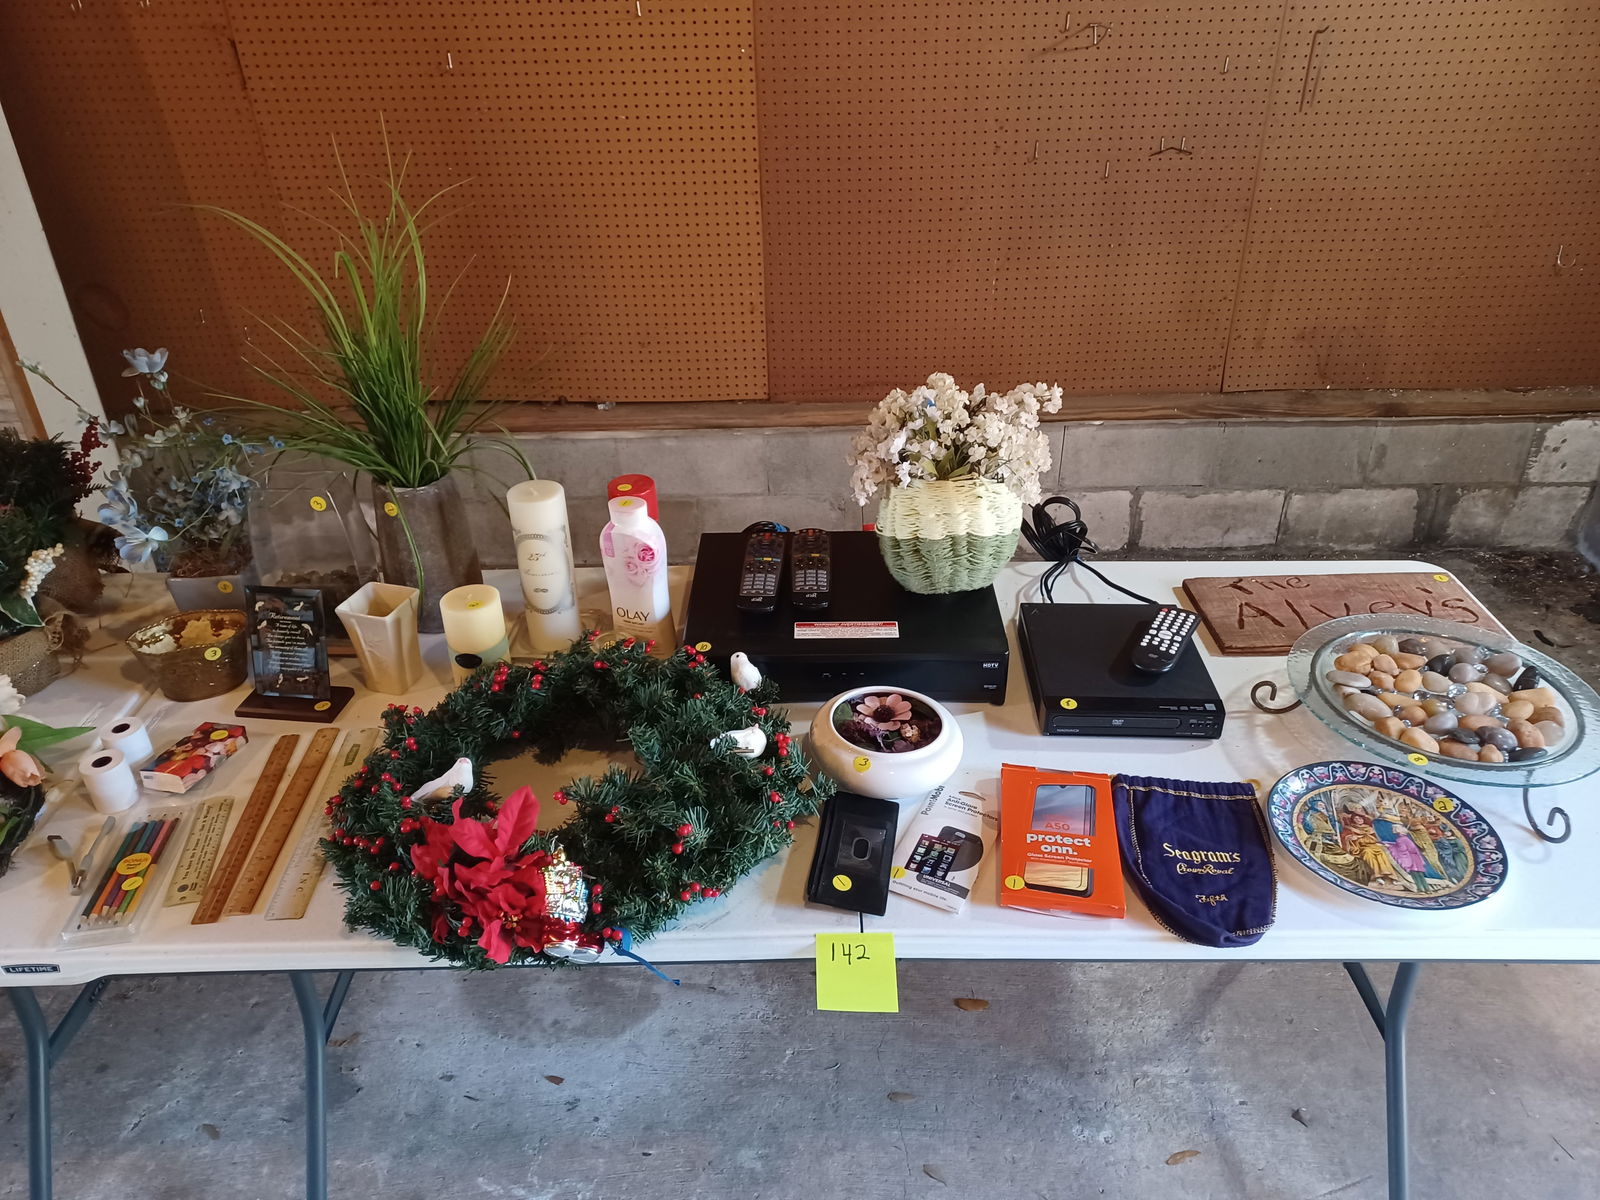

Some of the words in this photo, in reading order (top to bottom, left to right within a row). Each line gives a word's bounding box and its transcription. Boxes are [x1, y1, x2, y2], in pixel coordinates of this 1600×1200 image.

[616, 606, 650, 622] OLAY
[858, 757, 870, 767] 3
[1437, 800, 1449, 811] 2
[1044, 822, 1071, 831] A50
[1026, 833, 1092, 848] protect
[1040, 844, 1079, 856] onn.
[1162, 842, 1241, 865] Seagram's
[831, 942, 871, 965] 142
